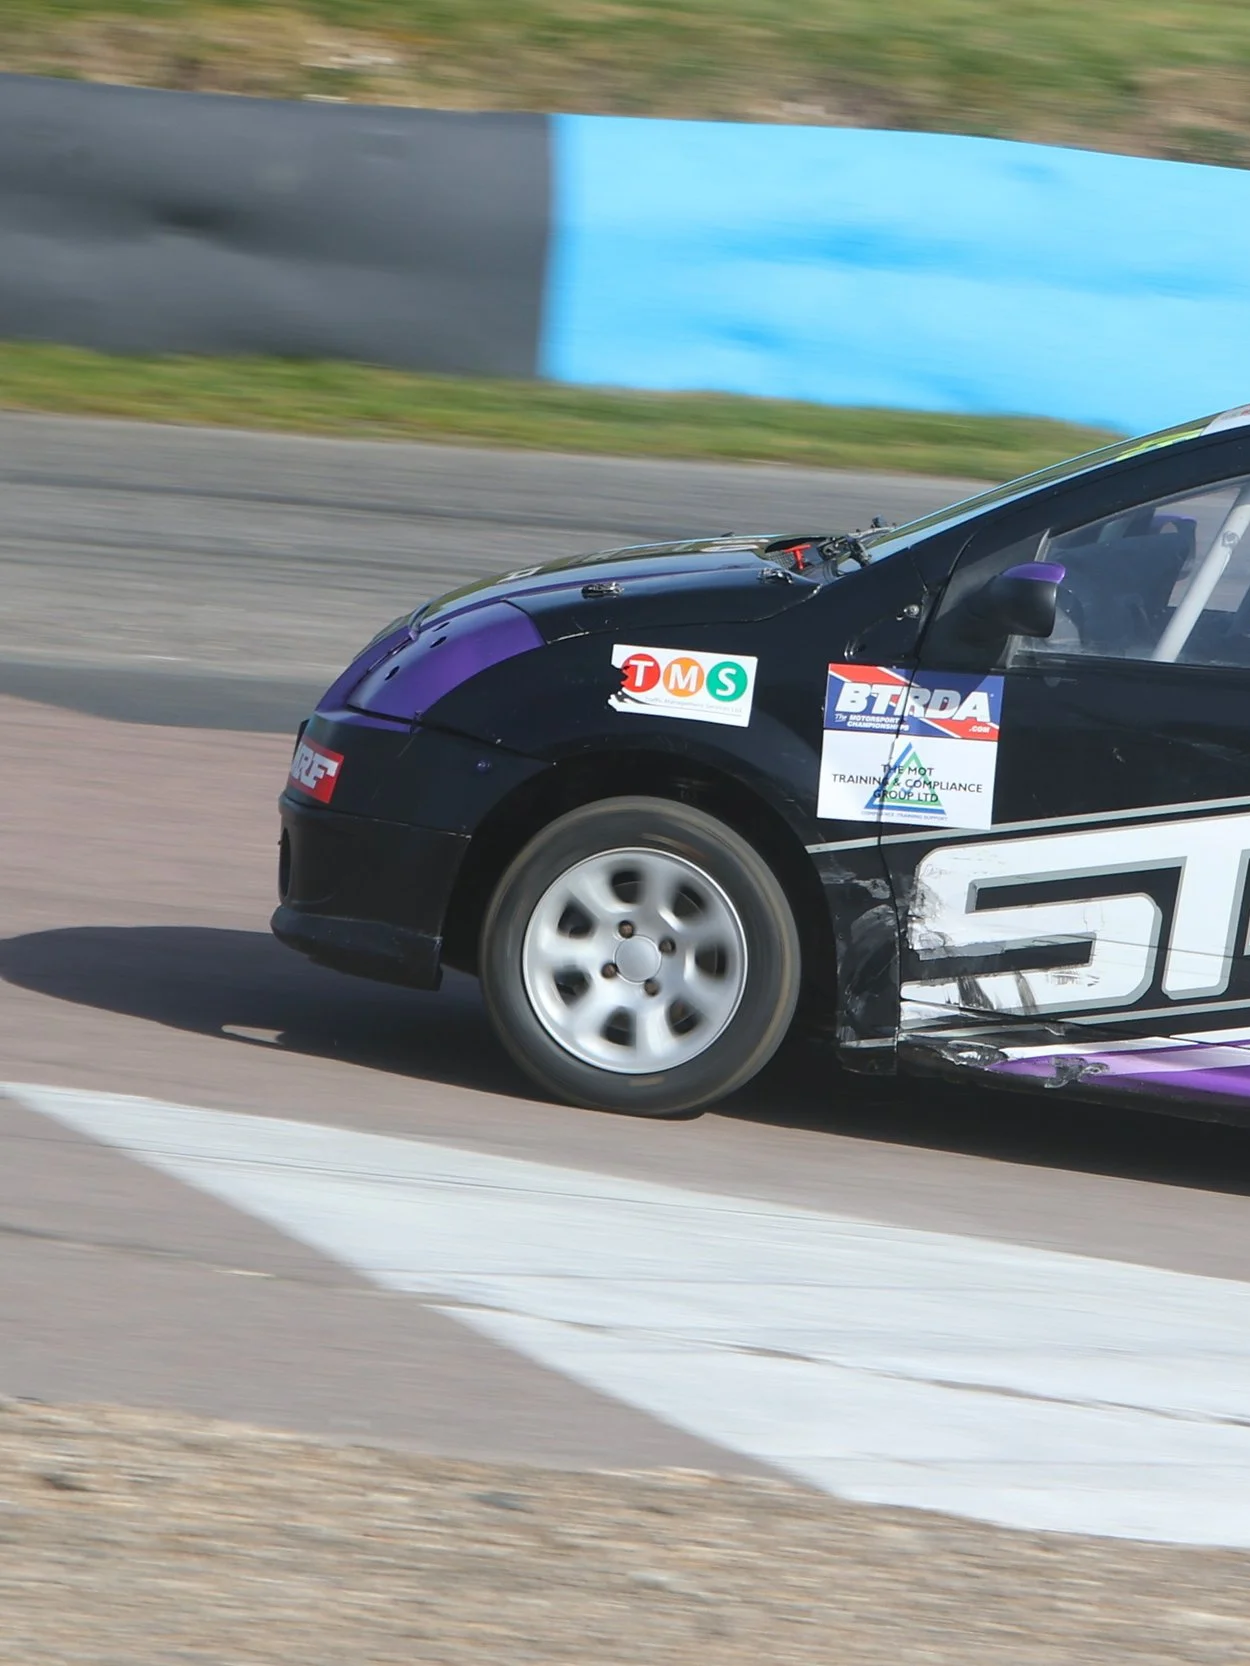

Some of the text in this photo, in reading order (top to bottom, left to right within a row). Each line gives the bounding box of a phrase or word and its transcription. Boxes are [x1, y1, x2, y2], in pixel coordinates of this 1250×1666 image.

[628, 659, 738, 697] TMS
[835, 682, 991, 722] BTRDA
[881, 764, 934, 776] THE MOT
[832, 774, 983, 793] TRAINING & COMPLIANCE
[873, 789, 939, 802] GROUP LTD
